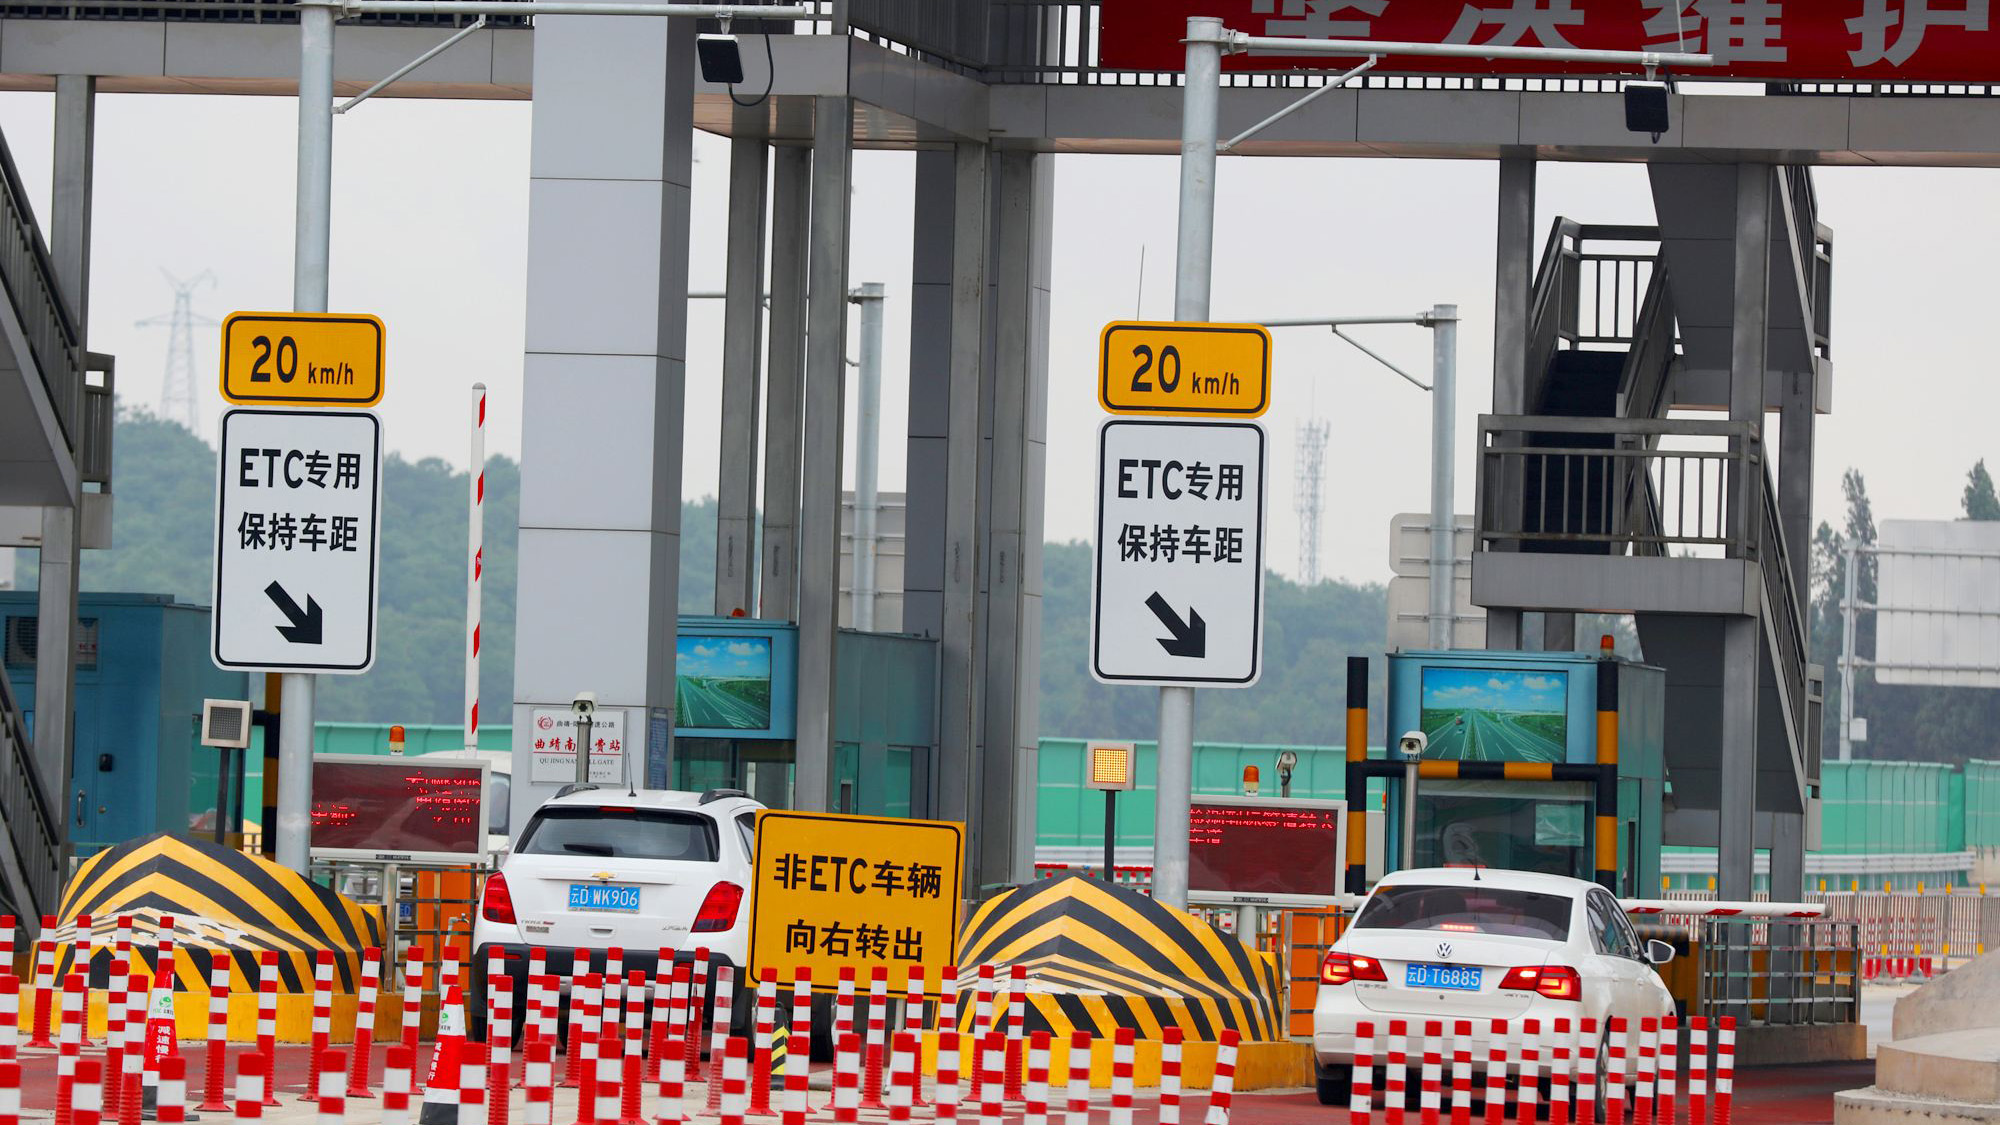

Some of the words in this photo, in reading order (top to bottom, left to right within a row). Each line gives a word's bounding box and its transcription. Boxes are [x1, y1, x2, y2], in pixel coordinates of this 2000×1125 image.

[250, 335, 298, 384] 20
[308, 361, 354, 386] km/h
[1130, 344, 1181, 393] 20
[1192, 371, 1240, 396] km/h
[239, 447, 361, 490] ETC专用
[1117, 458, 1244, 501] ETC专用
[237, 511, 359, 552] 保持车距
[1117, 523, 1244, 564] 保持车距
[534, 736, 621, 753] 曲靖南费站
[773, 853, 942, 899] 非ETC车辆
[785, 919, 923, 963] 向右转出
